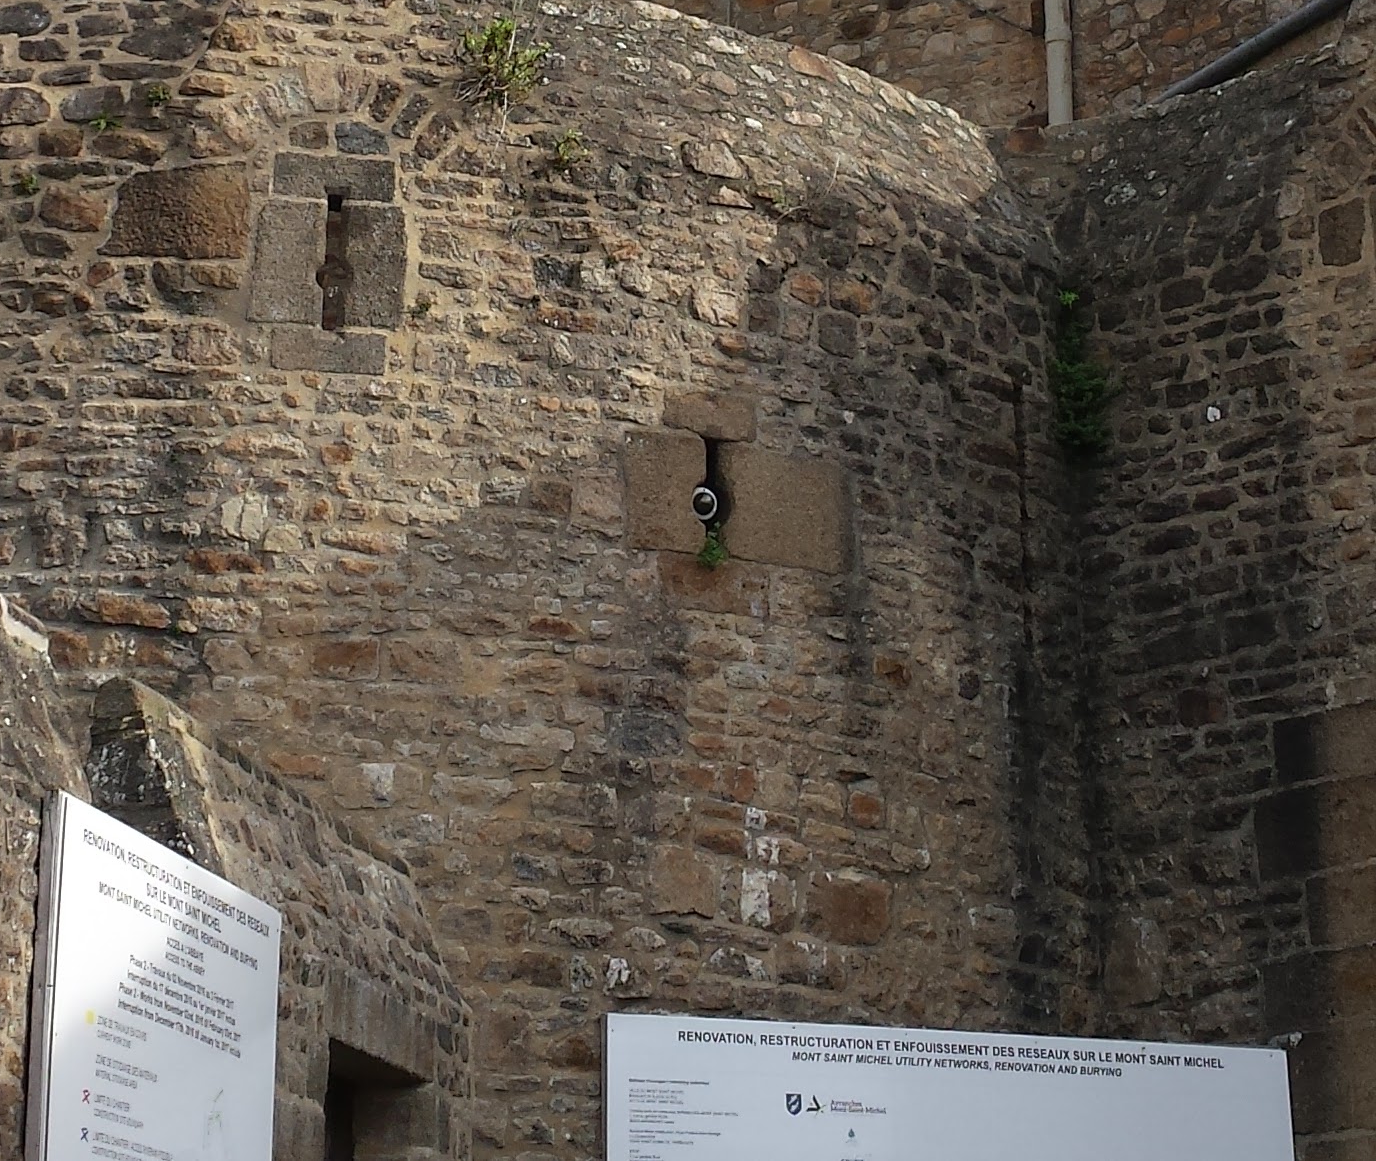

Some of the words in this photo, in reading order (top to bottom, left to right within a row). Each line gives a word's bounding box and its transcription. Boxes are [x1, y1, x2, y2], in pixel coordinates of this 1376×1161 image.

[83, 829, 127, 864] RENOVATION,
[127, 851, 182, 891] RESTRUCTURATION
[183, 881, 191, 895] ET
[191, 885, 235, 919] ENFOUISSEMENT
[236, 909, 247, 926] DES
[248, 914, 270, 937] RESEAUX
[146, 883, 158, 900] SUR
[159, 889, 167, 904] LE
[168, 893, 184, 915] MONT
[185, 902, 201, 922] SAINT
[202, 911, 222, 934] MICHEL
[98, 881, 115, 899] MONT
[116, 889, 132, 906] SAINT
[133, 898, 152, 919] MICHEL
[153, 907, 172, 927] UTILITY
[200, 930, 229, 954] RENOVATION
[240, 952, 258, 971] BURYING
[678, 1030, 757, 1046] RENOVATION,
[760, 1034, 873, 1050] RESTRUCTURATION
[877, 1041, 891, 1051] ET
[894, 1042, 989, 1056] ENFOUISSEMENT
[992, 1046, 1016, 1057] DES
[1018, 1047, 1071, 1061] RESEAUX
[1073, 1050, 1096, 1062] SUR
[1099, 1052, 1112, 1063] LE
[1115, 1053, 1147, 1065] MONT
[1149, 1054, 1181, 1067] SAINT
[1183, 1057, 1224, 1069] MICHEL
[792, 1052, 821, 1062] MONT
[824, 1053, 854, 1063] SAINT
[856, 1054, 892, 1065] MICHEL
[895, 1057, 933, 1067] UTILITY
[934, 1059, 992, 1071] NETWORKS,
[994, 1060, 1056, 1074] RENOVATION
[1058, 1064, 1078, 1075] AND
[1080, 1065, 1122, 1077] BURYING
